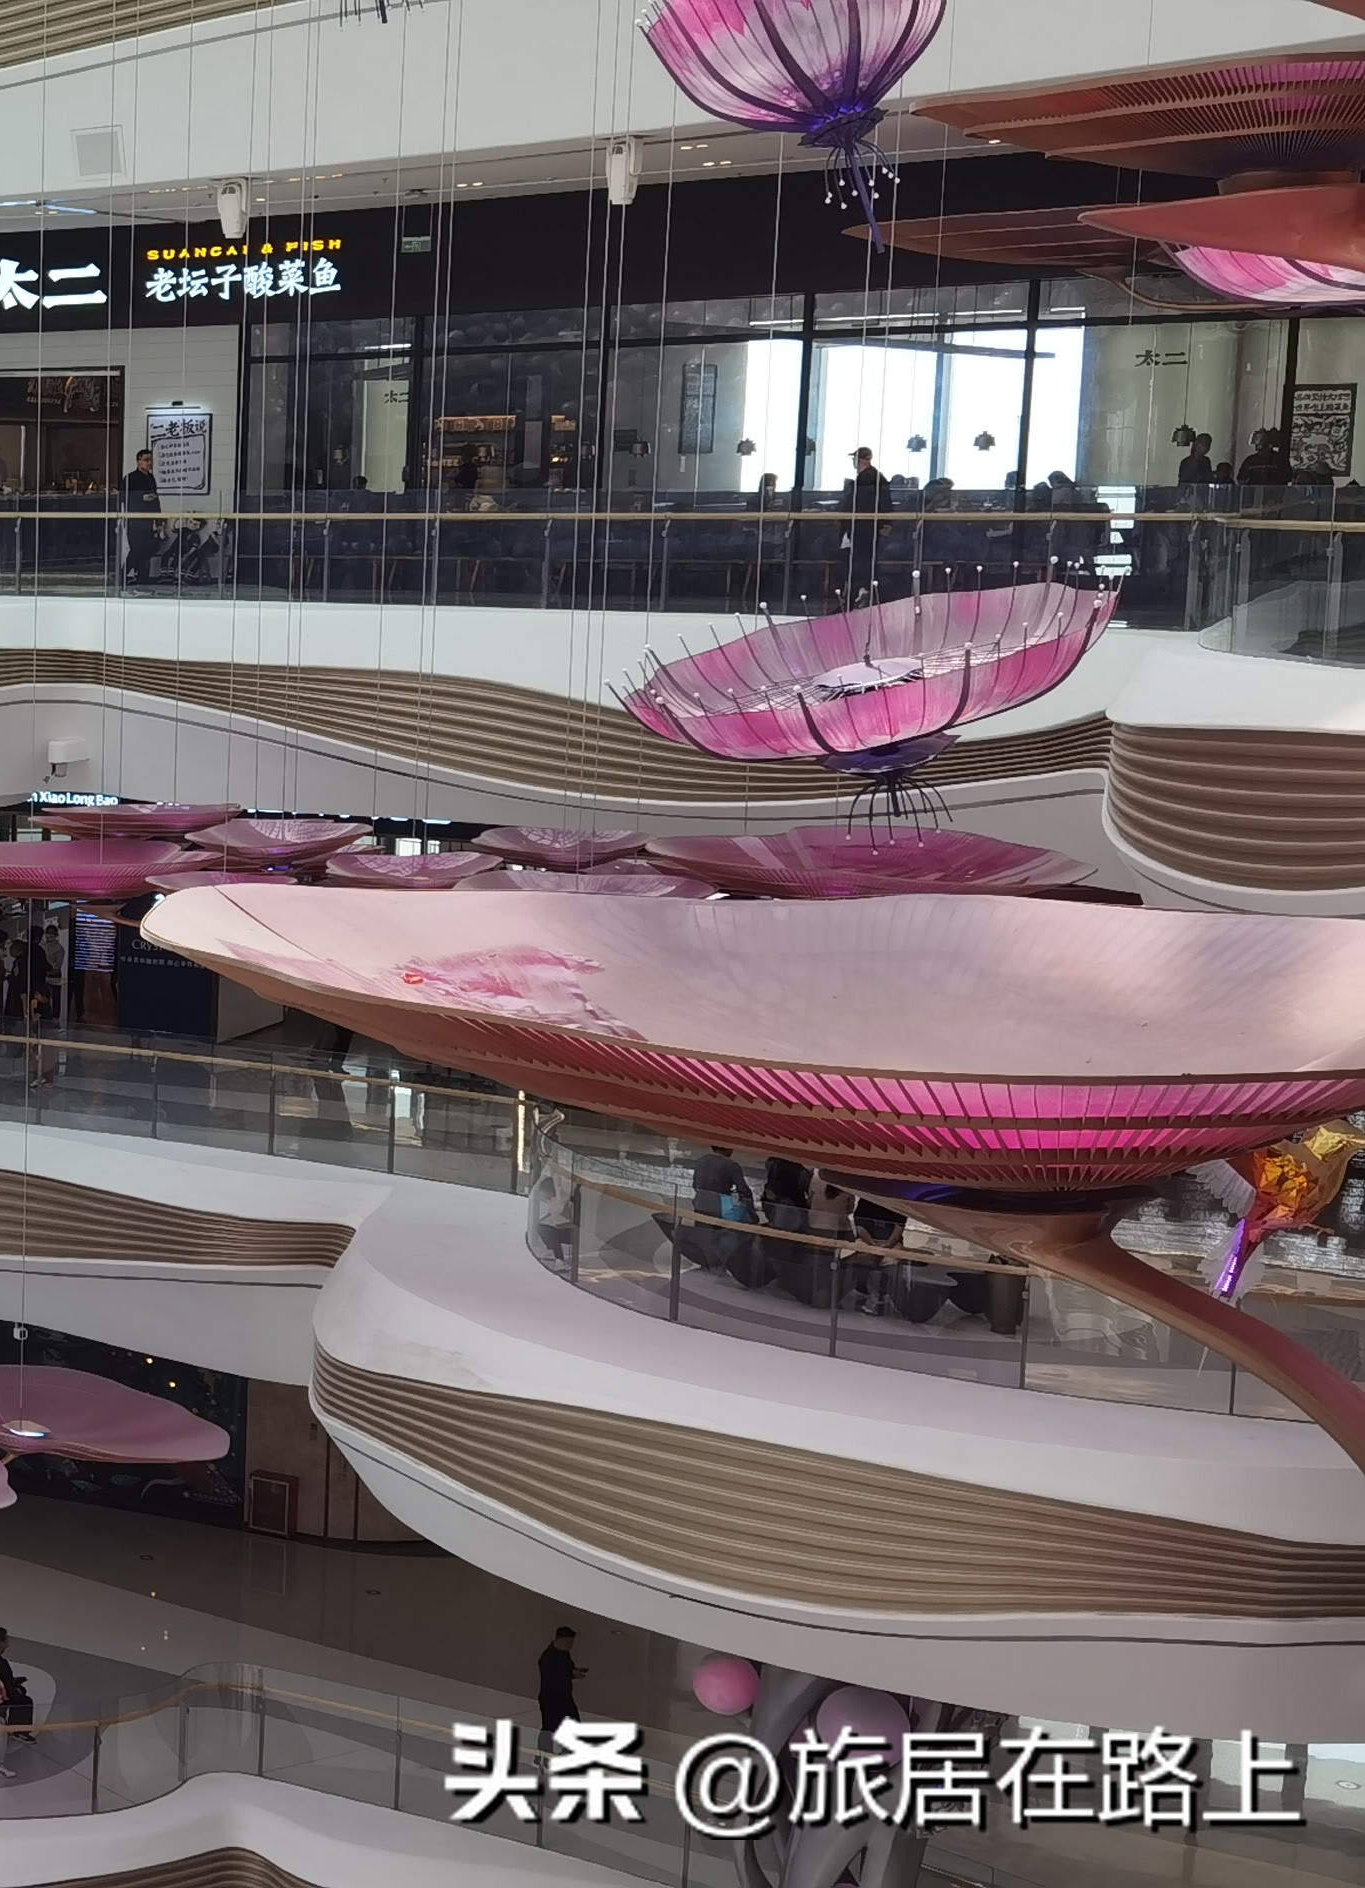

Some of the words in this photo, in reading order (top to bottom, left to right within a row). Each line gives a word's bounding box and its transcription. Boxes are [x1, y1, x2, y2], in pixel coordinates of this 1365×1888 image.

[146, 245, 248, 261] SUANCAI
[261, 243, 273, 255] &
[286, 239, 343, 252] FISH
[145, 256, 342, 303] 老坛子酸菜鱼
[1134, 349, 1188, 367] 太二
[39, 791, 65, 804] Xiao
[66, 792, 95, 807] Long
[96, 794, 119, 806] Bao
